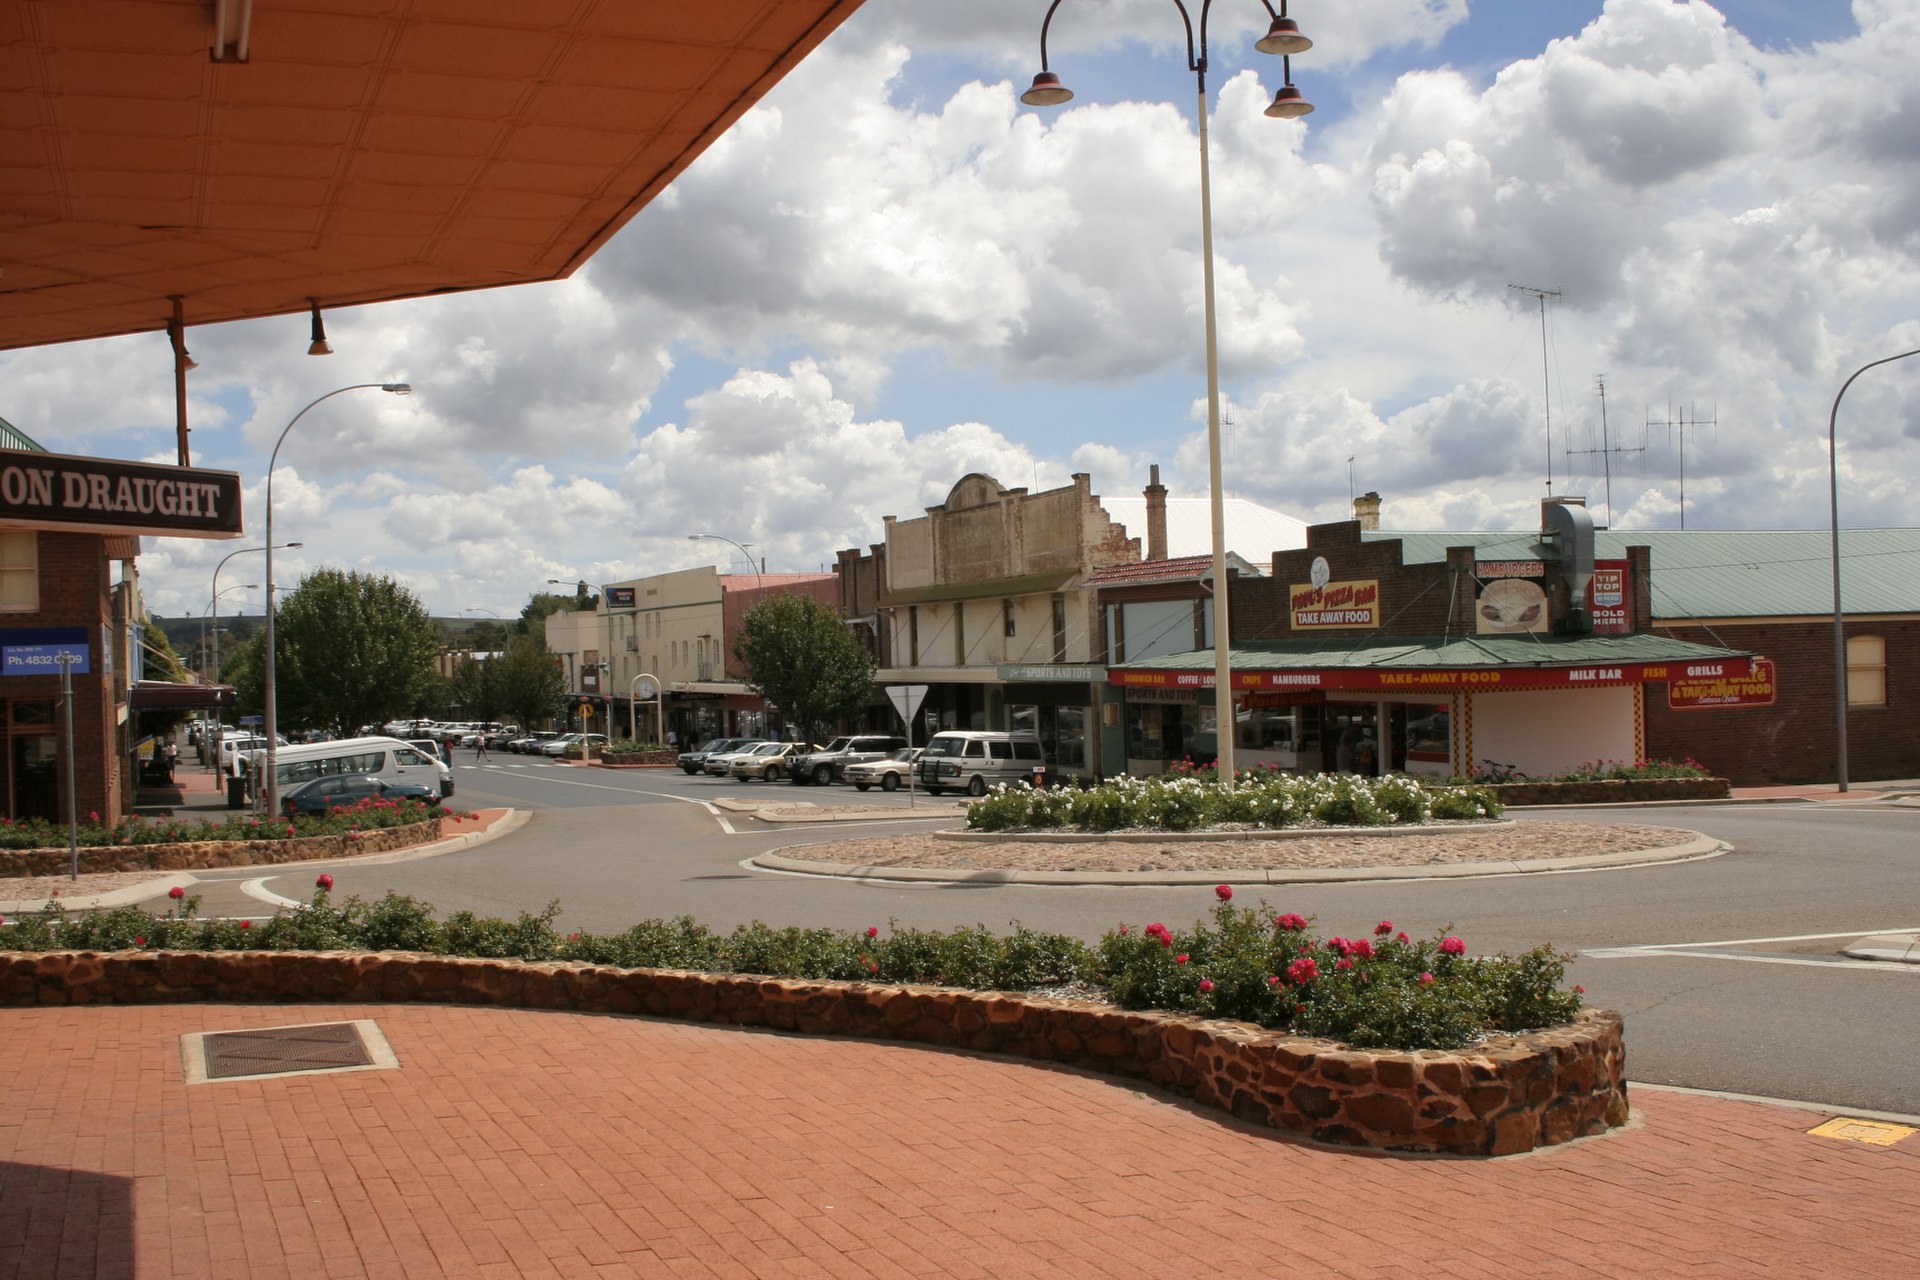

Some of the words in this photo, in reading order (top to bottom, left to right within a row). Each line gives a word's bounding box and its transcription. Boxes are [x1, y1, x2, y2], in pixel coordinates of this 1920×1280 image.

[1, 466, 54, 506] ON
[61, 471, 221, 518] DRAUGHT
[1477, 562, 1544, 578] HAMBURGERS
[1324, 586, 1353, 609] PIZZA
[1354, 584, 1377, 607] BAR
[1297, 612, 1319, 624] TAKE
[1320, 611, 1345, 624] AWAY
[1345, 610, 1370, 623] FOOD
[8, 656, 24, 665] Ph.
[25, 656, 53, 665] 4832
[54, 655, 83, 664] 009
[1026, 667, 1054, 679] SPORTS
[1055, 668, 1072, 679] AND
[1072, 668, 1092, 679] TOYS
[1569, 669, 1597, 681] MILK
[1598, 668, 1622, 680] BAR
[1644, 668, 1667, 678] FISH
[1687, 665, 1723, 676] GRILLS
[1124, 674, 1152, 684] SANDWICH
[1153, 675, 1166, 684] BAR
[1177, 675, 1198, 684] COFFEE
[1203, 675, 1217, 684] LOU
[1242, 675, 1262, 685] CHIPS
[1272, 674, 1321, 685] HAMBURGERS
[1379, 671, 1458, 684] TAKE-AWAY
[1461, 671, 1501, 683] FOOD
[1127, 688, 1157, 700] SPORTS
[1158, 689, 1175, 700] AND
[1176, 689, 1197, 701] TOYS
[1743, 683, 1772, 695] FOOD
